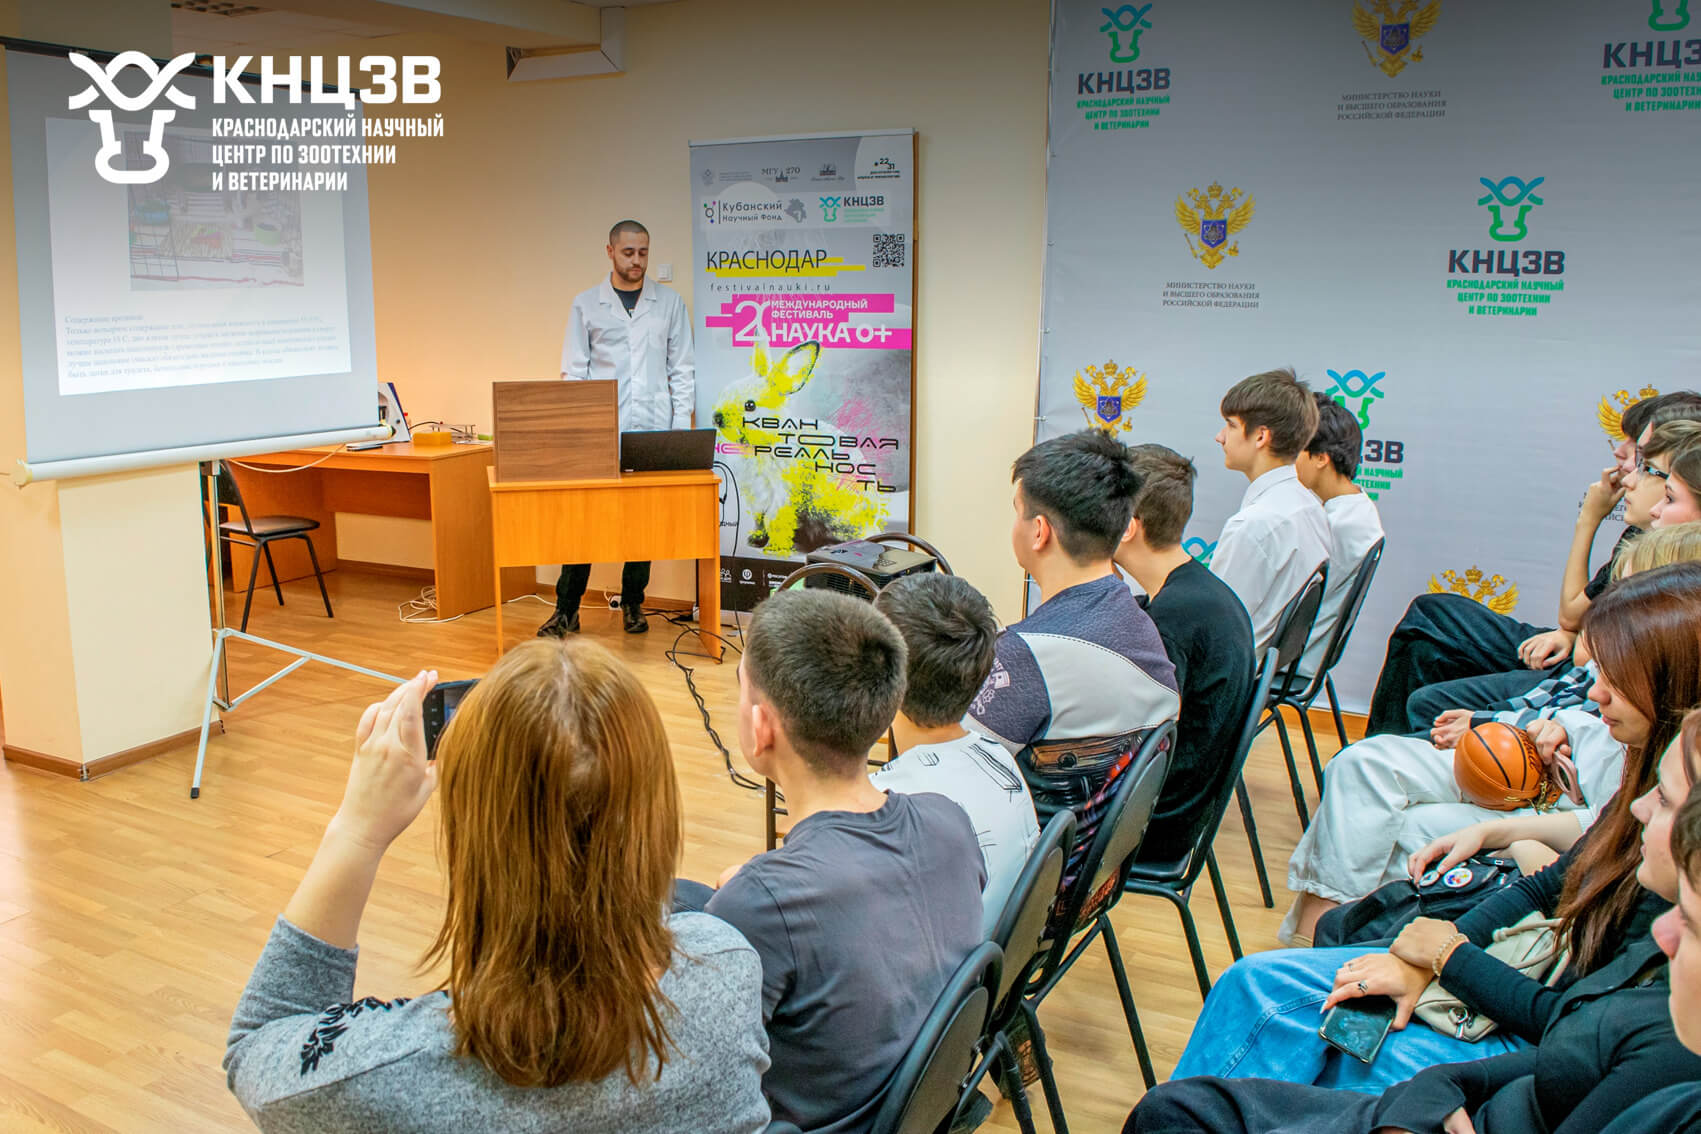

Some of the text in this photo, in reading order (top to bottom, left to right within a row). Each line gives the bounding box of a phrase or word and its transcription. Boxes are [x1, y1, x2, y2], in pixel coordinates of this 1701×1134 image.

[1078, 68, 1170, 95] КНЦЗВ
[1613, 87, 1643, 99] ЦЕНТР
[1646, 87, 1658, 97] ПО
[722, 200, 782, 212] Кубанский
[843, 195, 885, 207] КНЦЗВ
[722, 213, 758, 222] Научный
[706, 249, 828, 273] КРАСНОДАР
[1448, 249, 1566, 277] КНЦЗВ
[1165, 281, 1256, 290] МИНИСТЕРСТВО НАУКИ
[1446, 278, 1564, 291] КРАСНОДАРСКИЙ НАУЧНЫЙ
[1206, 291, 1260, 300] ОБРАЗОВАНИЯ
[1457, 292, 1551, 304] ЦЕНТР ПО ЗООТЕХНИИ
[771, 298, 868, 310] МЕЖДУНАРОДНЫЙ
[771, 310, 834, 319] ФЕСТИВАЛЬ
[1476, 305, 1538, 316] ВЕТЕРИНАРИИ
[771, 322, 851, 342] НАУКА
[742, 417, 818, 430] КВАН
[778, 432, 899, 450] ТОВАЯ
[754, 446, 850, 460] РЕАЛЬ
[815, 461, 876, 475] НОС
[856, 480, 897, 493] ТЬ
